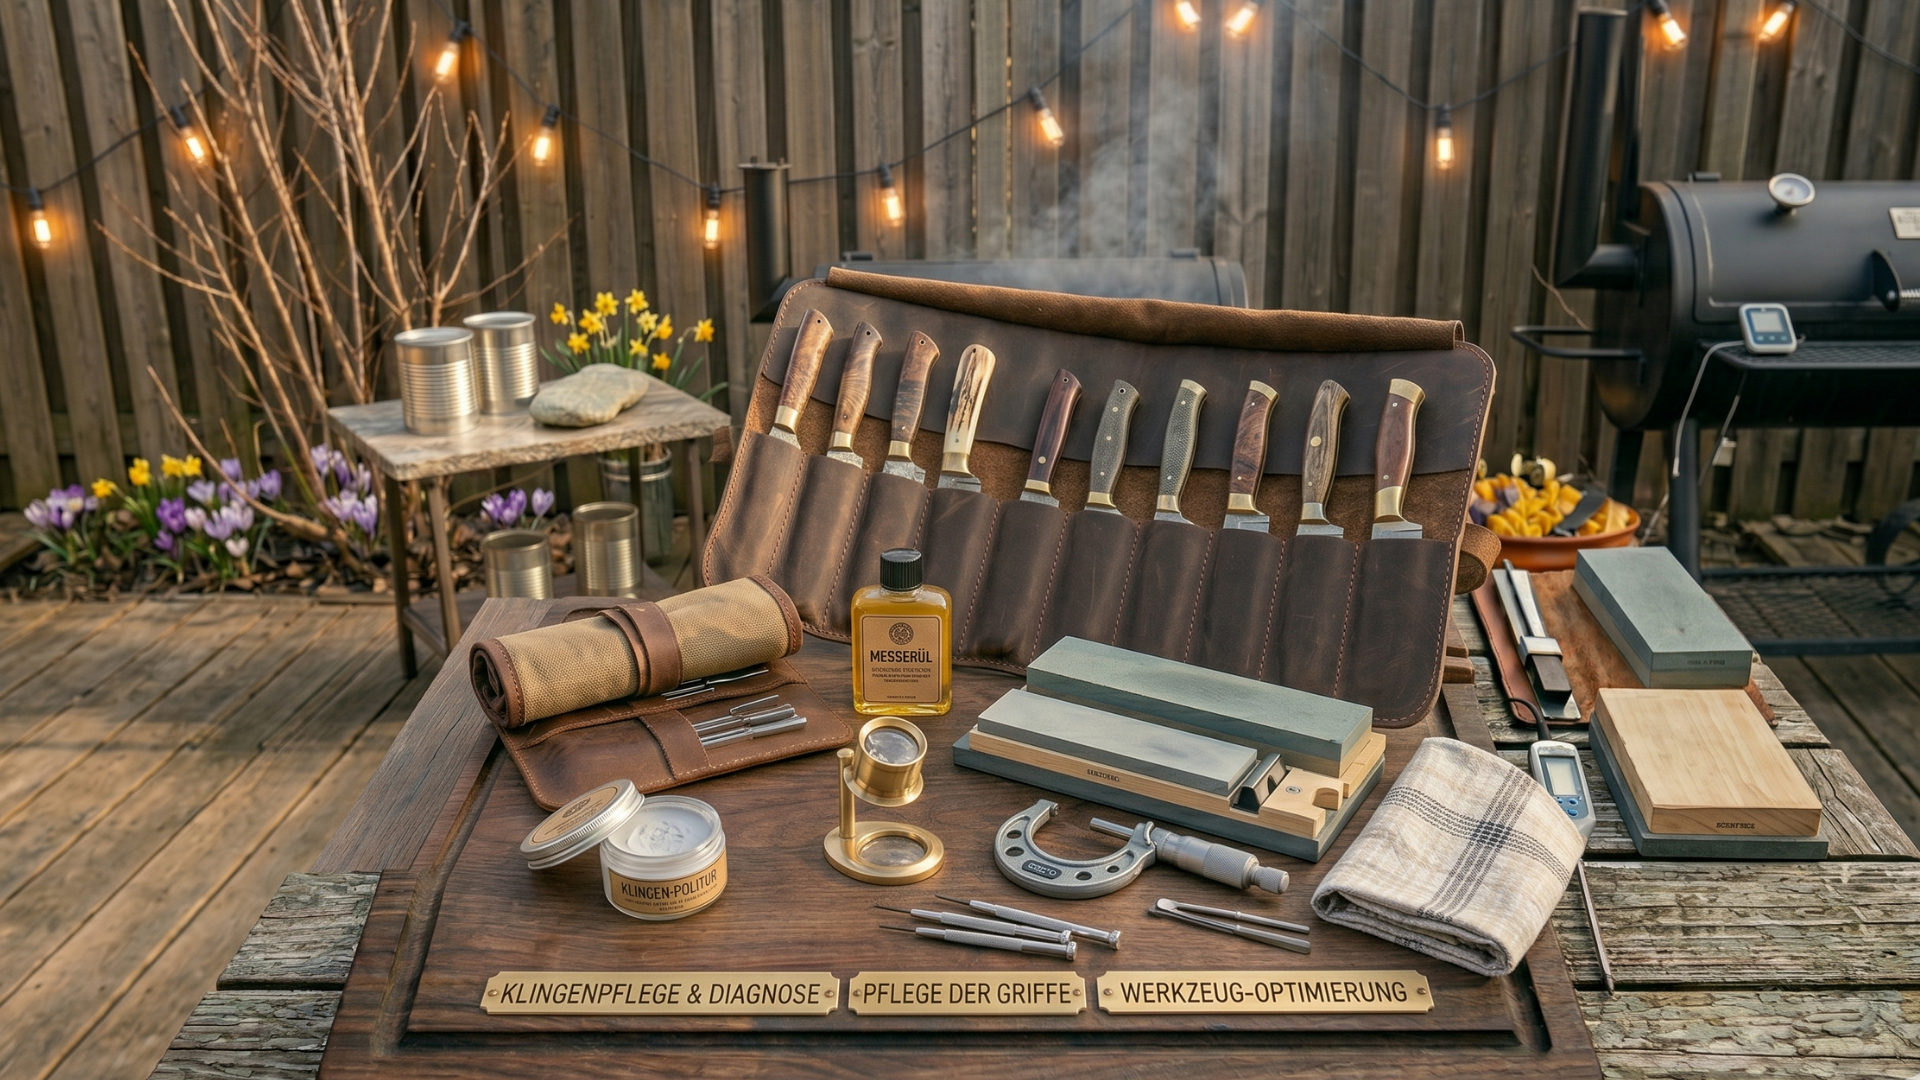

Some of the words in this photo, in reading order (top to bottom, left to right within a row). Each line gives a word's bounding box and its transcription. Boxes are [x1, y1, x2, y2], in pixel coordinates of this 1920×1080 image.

[870, 648, 933, 663] MESSERÜL
[621, 869, 717, 900] KLINGEN-POLITUR
[500, 983, 682, 1004] KLINGENPFLEGE
[686, 983, 702, 1004] &
[709, 983, 821, 1005] DIAGNOSE
[863, 983, 943, 1004] PFLEGE
[949, 983, 991, 1004] DER
[997, 983, 1072, 1004] GRIFFE
[1121, 981, 1408, 1004] WERKZEUG-OPTIMIERUNG
